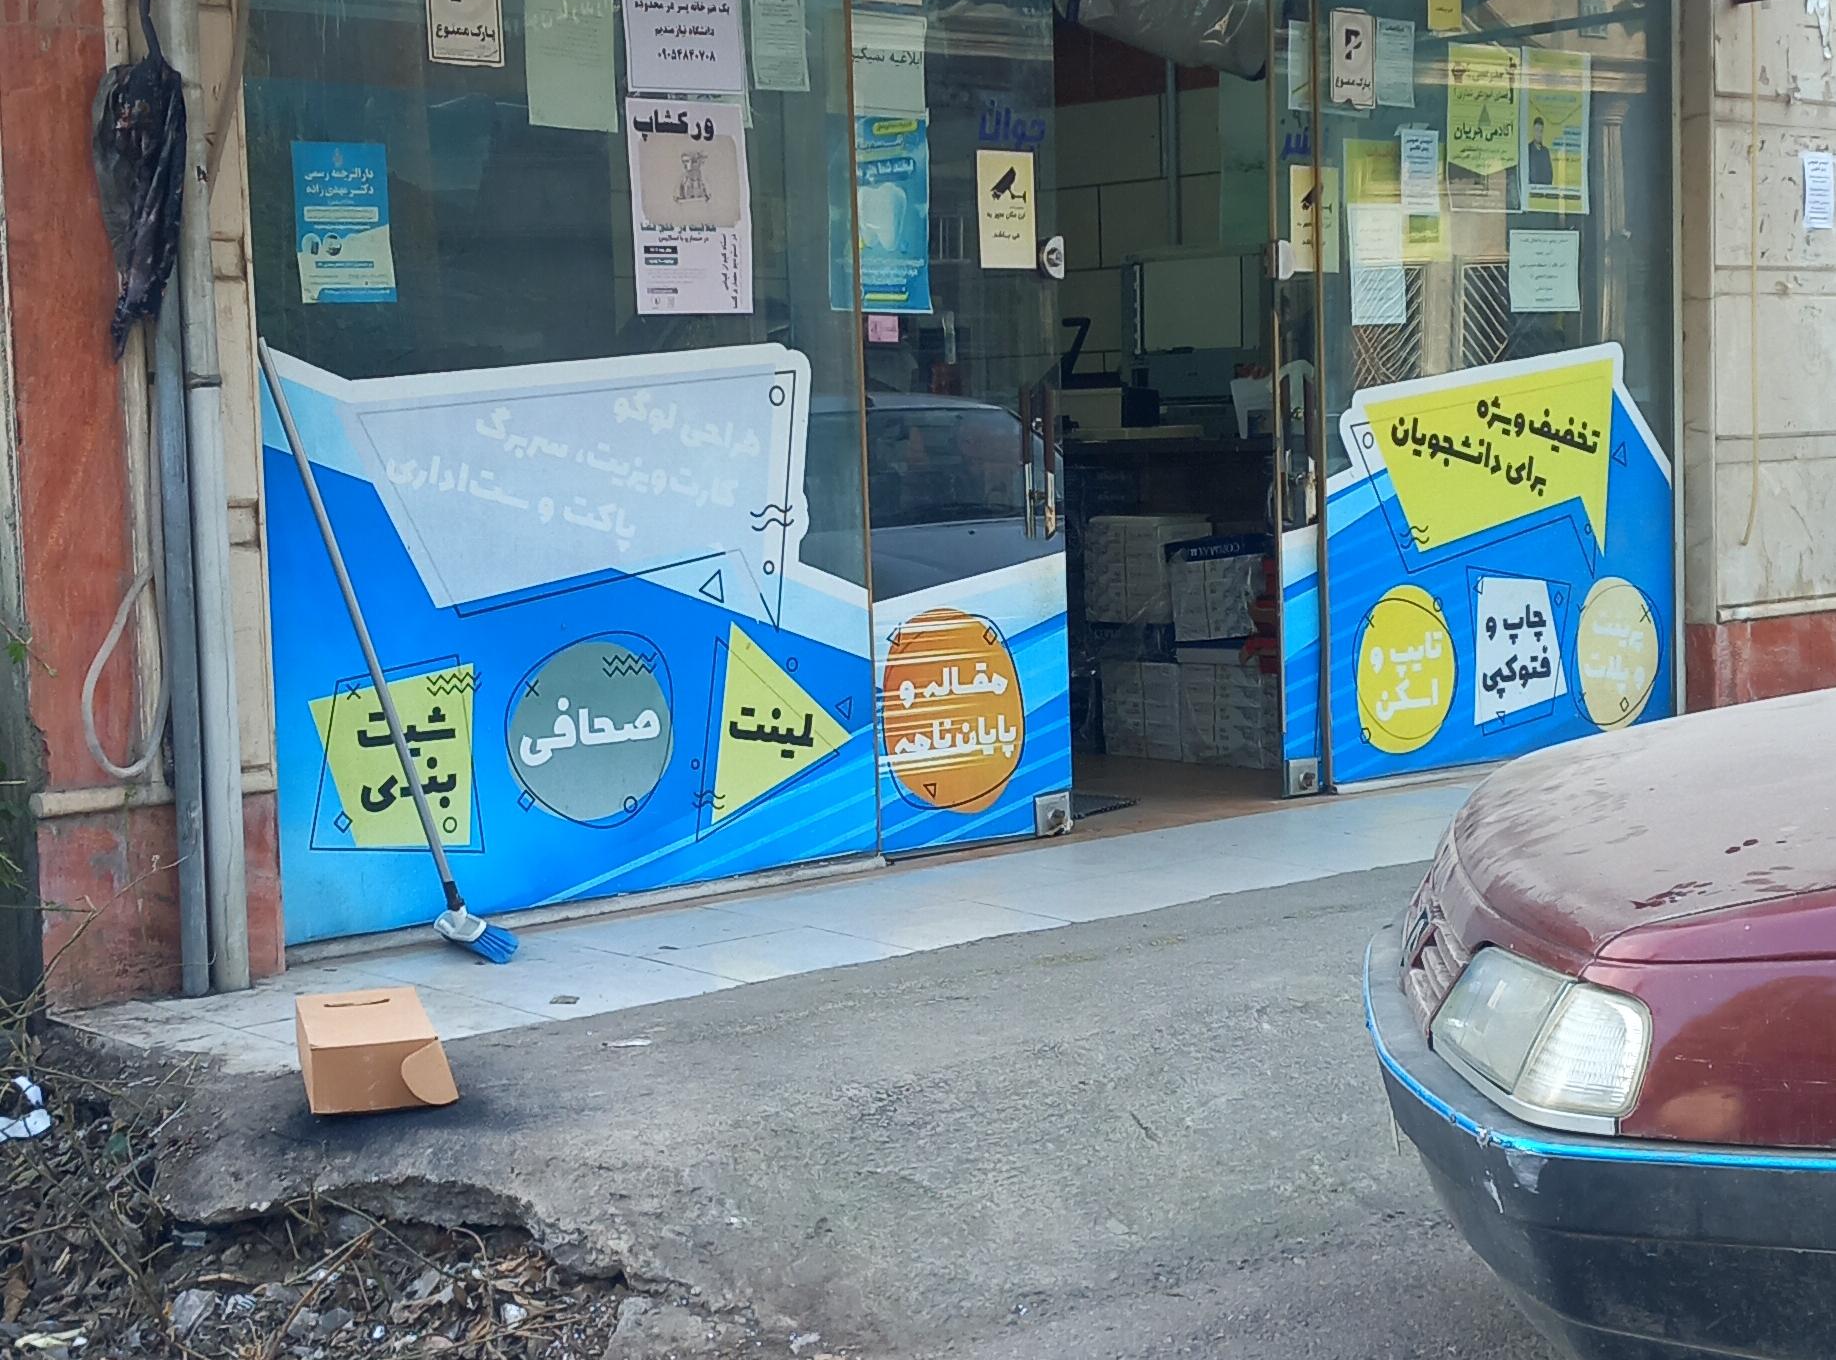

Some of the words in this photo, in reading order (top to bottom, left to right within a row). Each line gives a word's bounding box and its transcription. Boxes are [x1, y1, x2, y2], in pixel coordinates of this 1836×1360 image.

[436, 23, 470, 40] ممنوع
[471, 24, 496, 42] پارک
[688, 26, 715, 37] دانشگاه
[633, 109, 715, 143] ورکشاپ
[304, 170, 330, 181] رسمی
[331, 167, 374, 181] دارالترجمه
[349, 183, 374, 197] دکتر
[475, 406, 569, 459] سربرگ
[613, 389, 678, 435] لوگو
[1477, 395, 1526, 438] ویژه
[1529, 408, 1601, 454] تخفیف
[1391, 417, 1502, 475] دانشجویان
[1505, 455, 1547, 496] برای
[538, 495, 554, 525] و
[563, 495, 637, 552] پاکت
[1485, 616, 1497, 641] و
[1503, 604, 1547, 645] چاپ
[1370, 646, 1385, 674] و
[1390, 631, 1443, 678] تایپ
[1482, 645, 1552, 699] فتوکپی
[899, 680, 916, 709] و
[923, 662, 1009, 698] مقاله
[1375, 677, 1439, 722] اسکن
[357, 706, 456, 758] شیت
[519, 696, 662, 767] صحافی
[729, 706, 814, 759] لینت
